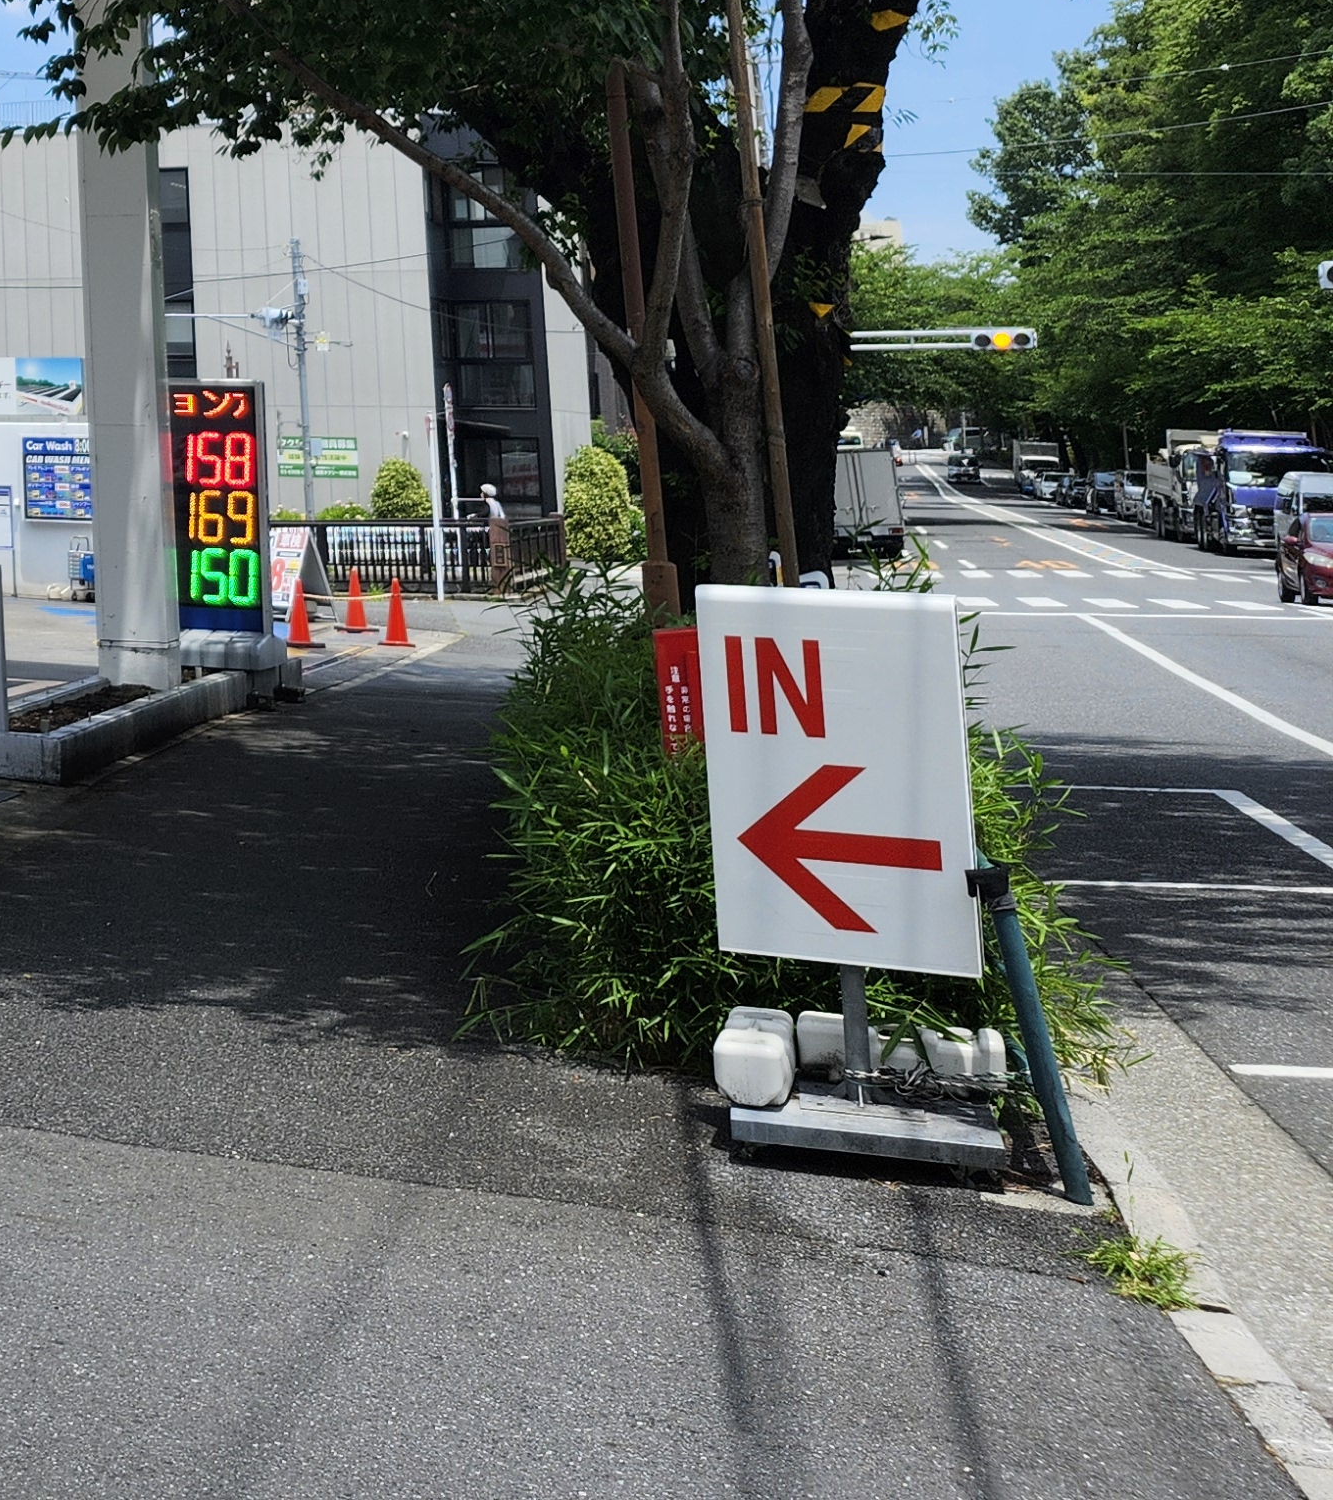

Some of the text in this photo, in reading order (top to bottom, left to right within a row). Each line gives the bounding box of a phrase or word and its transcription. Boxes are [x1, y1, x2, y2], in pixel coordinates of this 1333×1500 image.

[26, 440, 44, 451] Car
[46, 440, 73, 451] Wash
[26, 455, 44, 464] CAR
[45, 455, 72, 464] WASH
[186, 431, 252, 485] 158
[189, 490, 254, 544] 169
[190, 547, 259, 606] 150
[725, 635, 826, 738] IN
